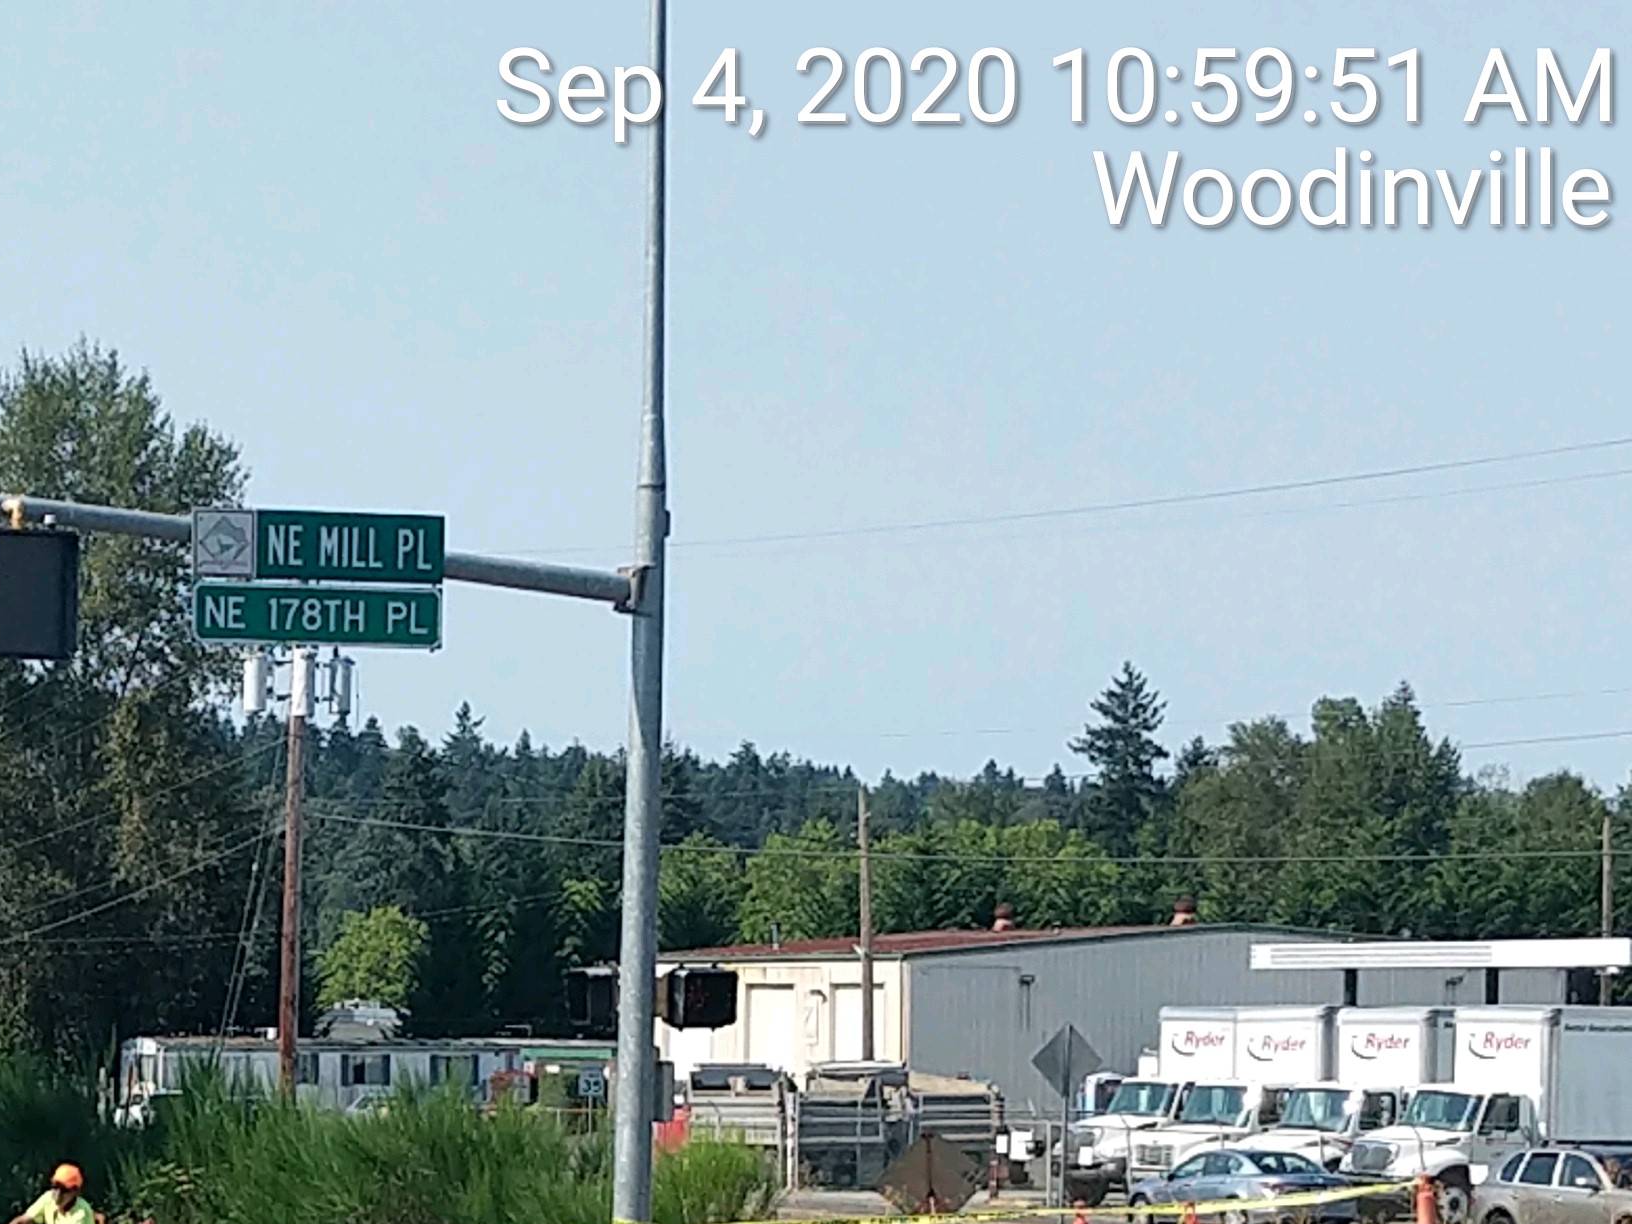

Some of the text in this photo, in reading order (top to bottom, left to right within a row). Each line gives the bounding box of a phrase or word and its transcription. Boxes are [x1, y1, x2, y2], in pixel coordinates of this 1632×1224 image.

[267, 524, 433, 570] NE MILL PL
[205, 595, 429, 634] NE 178TH PL
[1184, 1030, 1225, 1050] Ryder
[1261, 1035, 1306, 1054] Ryder
[1364, 1033, 1410, 1053] Ryder
[1483, 1031, 1531, 1053] Ryder
